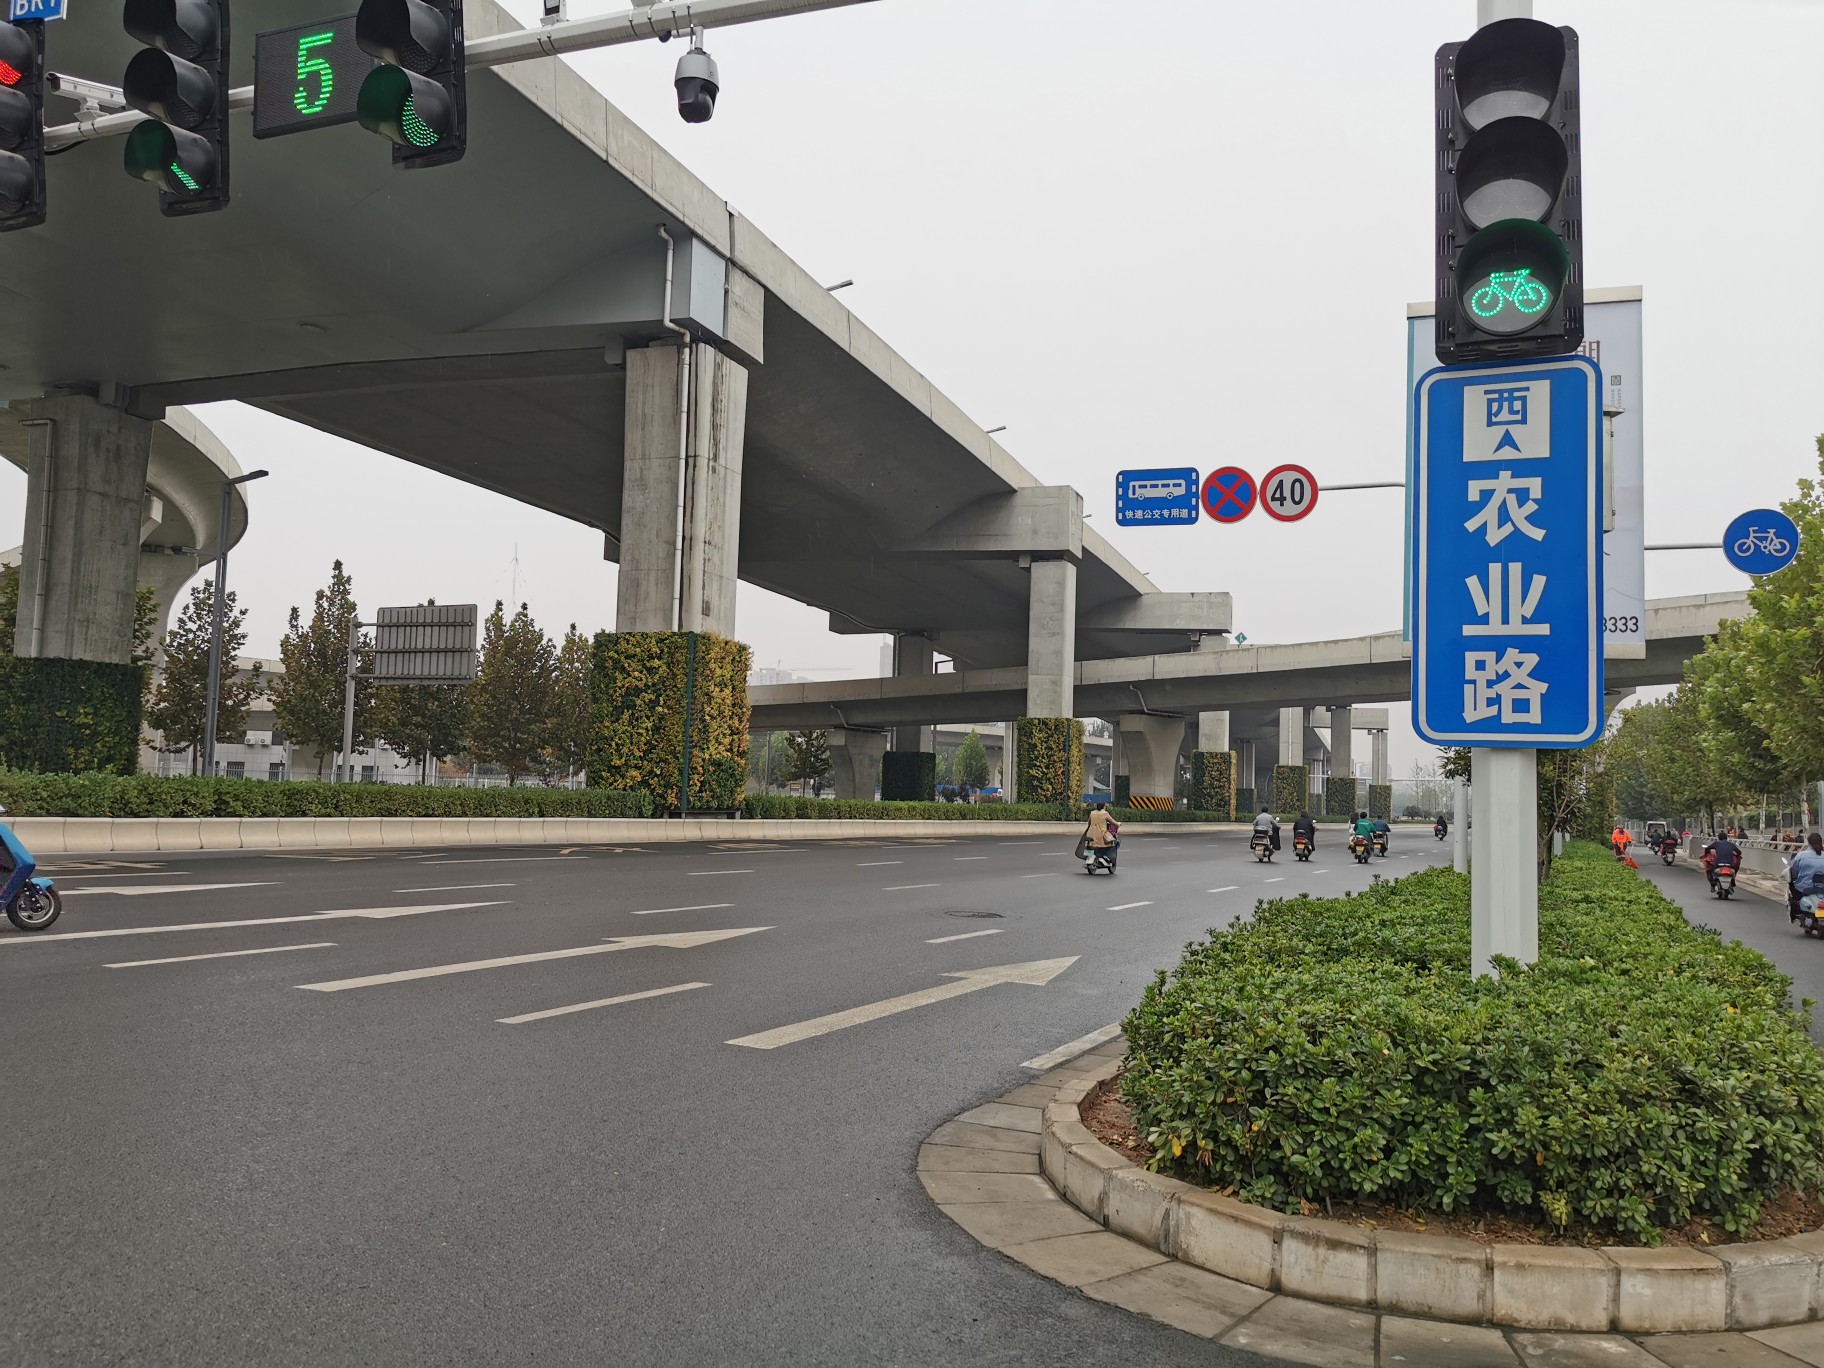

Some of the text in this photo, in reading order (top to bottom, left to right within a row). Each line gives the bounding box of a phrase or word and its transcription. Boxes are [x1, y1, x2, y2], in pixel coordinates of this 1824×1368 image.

[294, 32, 334, 115] 5
[1483, 386, 1530, 427] 西
[1270, 477, 1305, 507] 40
[1124, 508, 1189, 519] 快速公交专用道
[1462, 470, 1550, 725] 农业路
